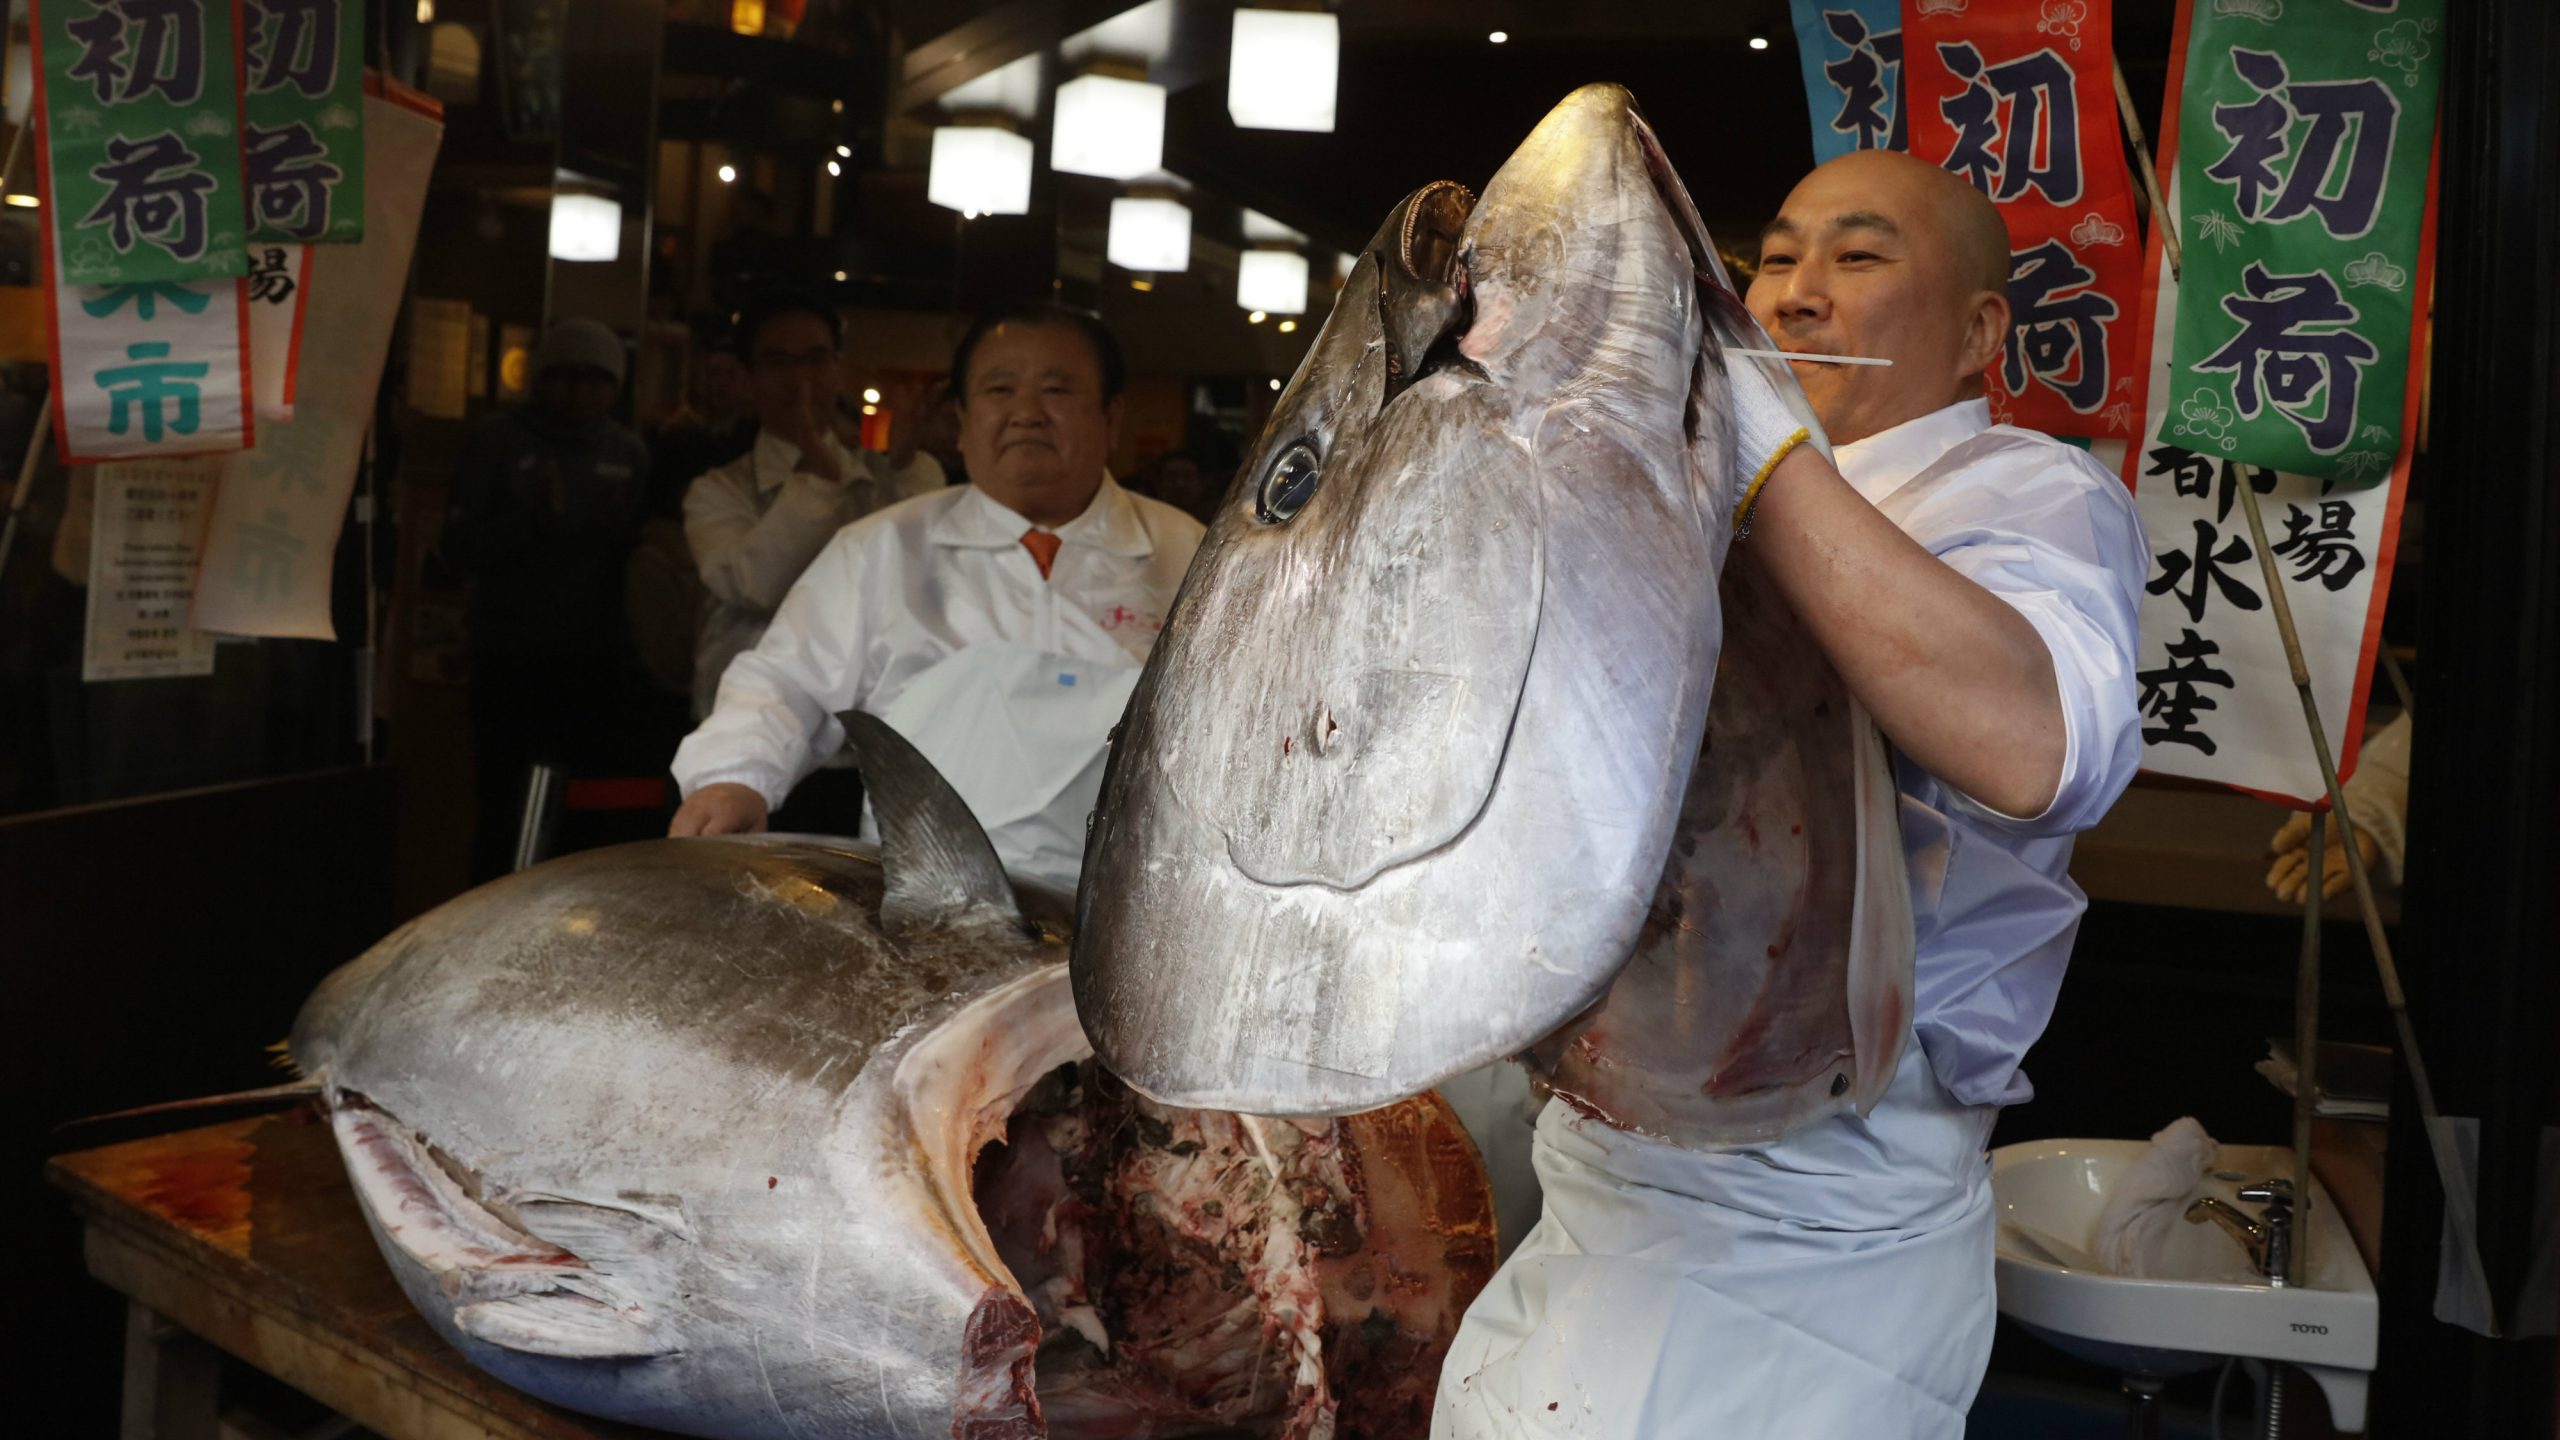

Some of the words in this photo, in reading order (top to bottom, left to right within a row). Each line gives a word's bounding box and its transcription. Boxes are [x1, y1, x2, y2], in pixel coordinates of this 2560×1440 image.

[66, 0, 217, 263] 初荷
[2190, 45, 2404, 457] 初荷
[2271, 480, 2366, 593] 場
[2289, 1322, 2329, 1336] TOTO
